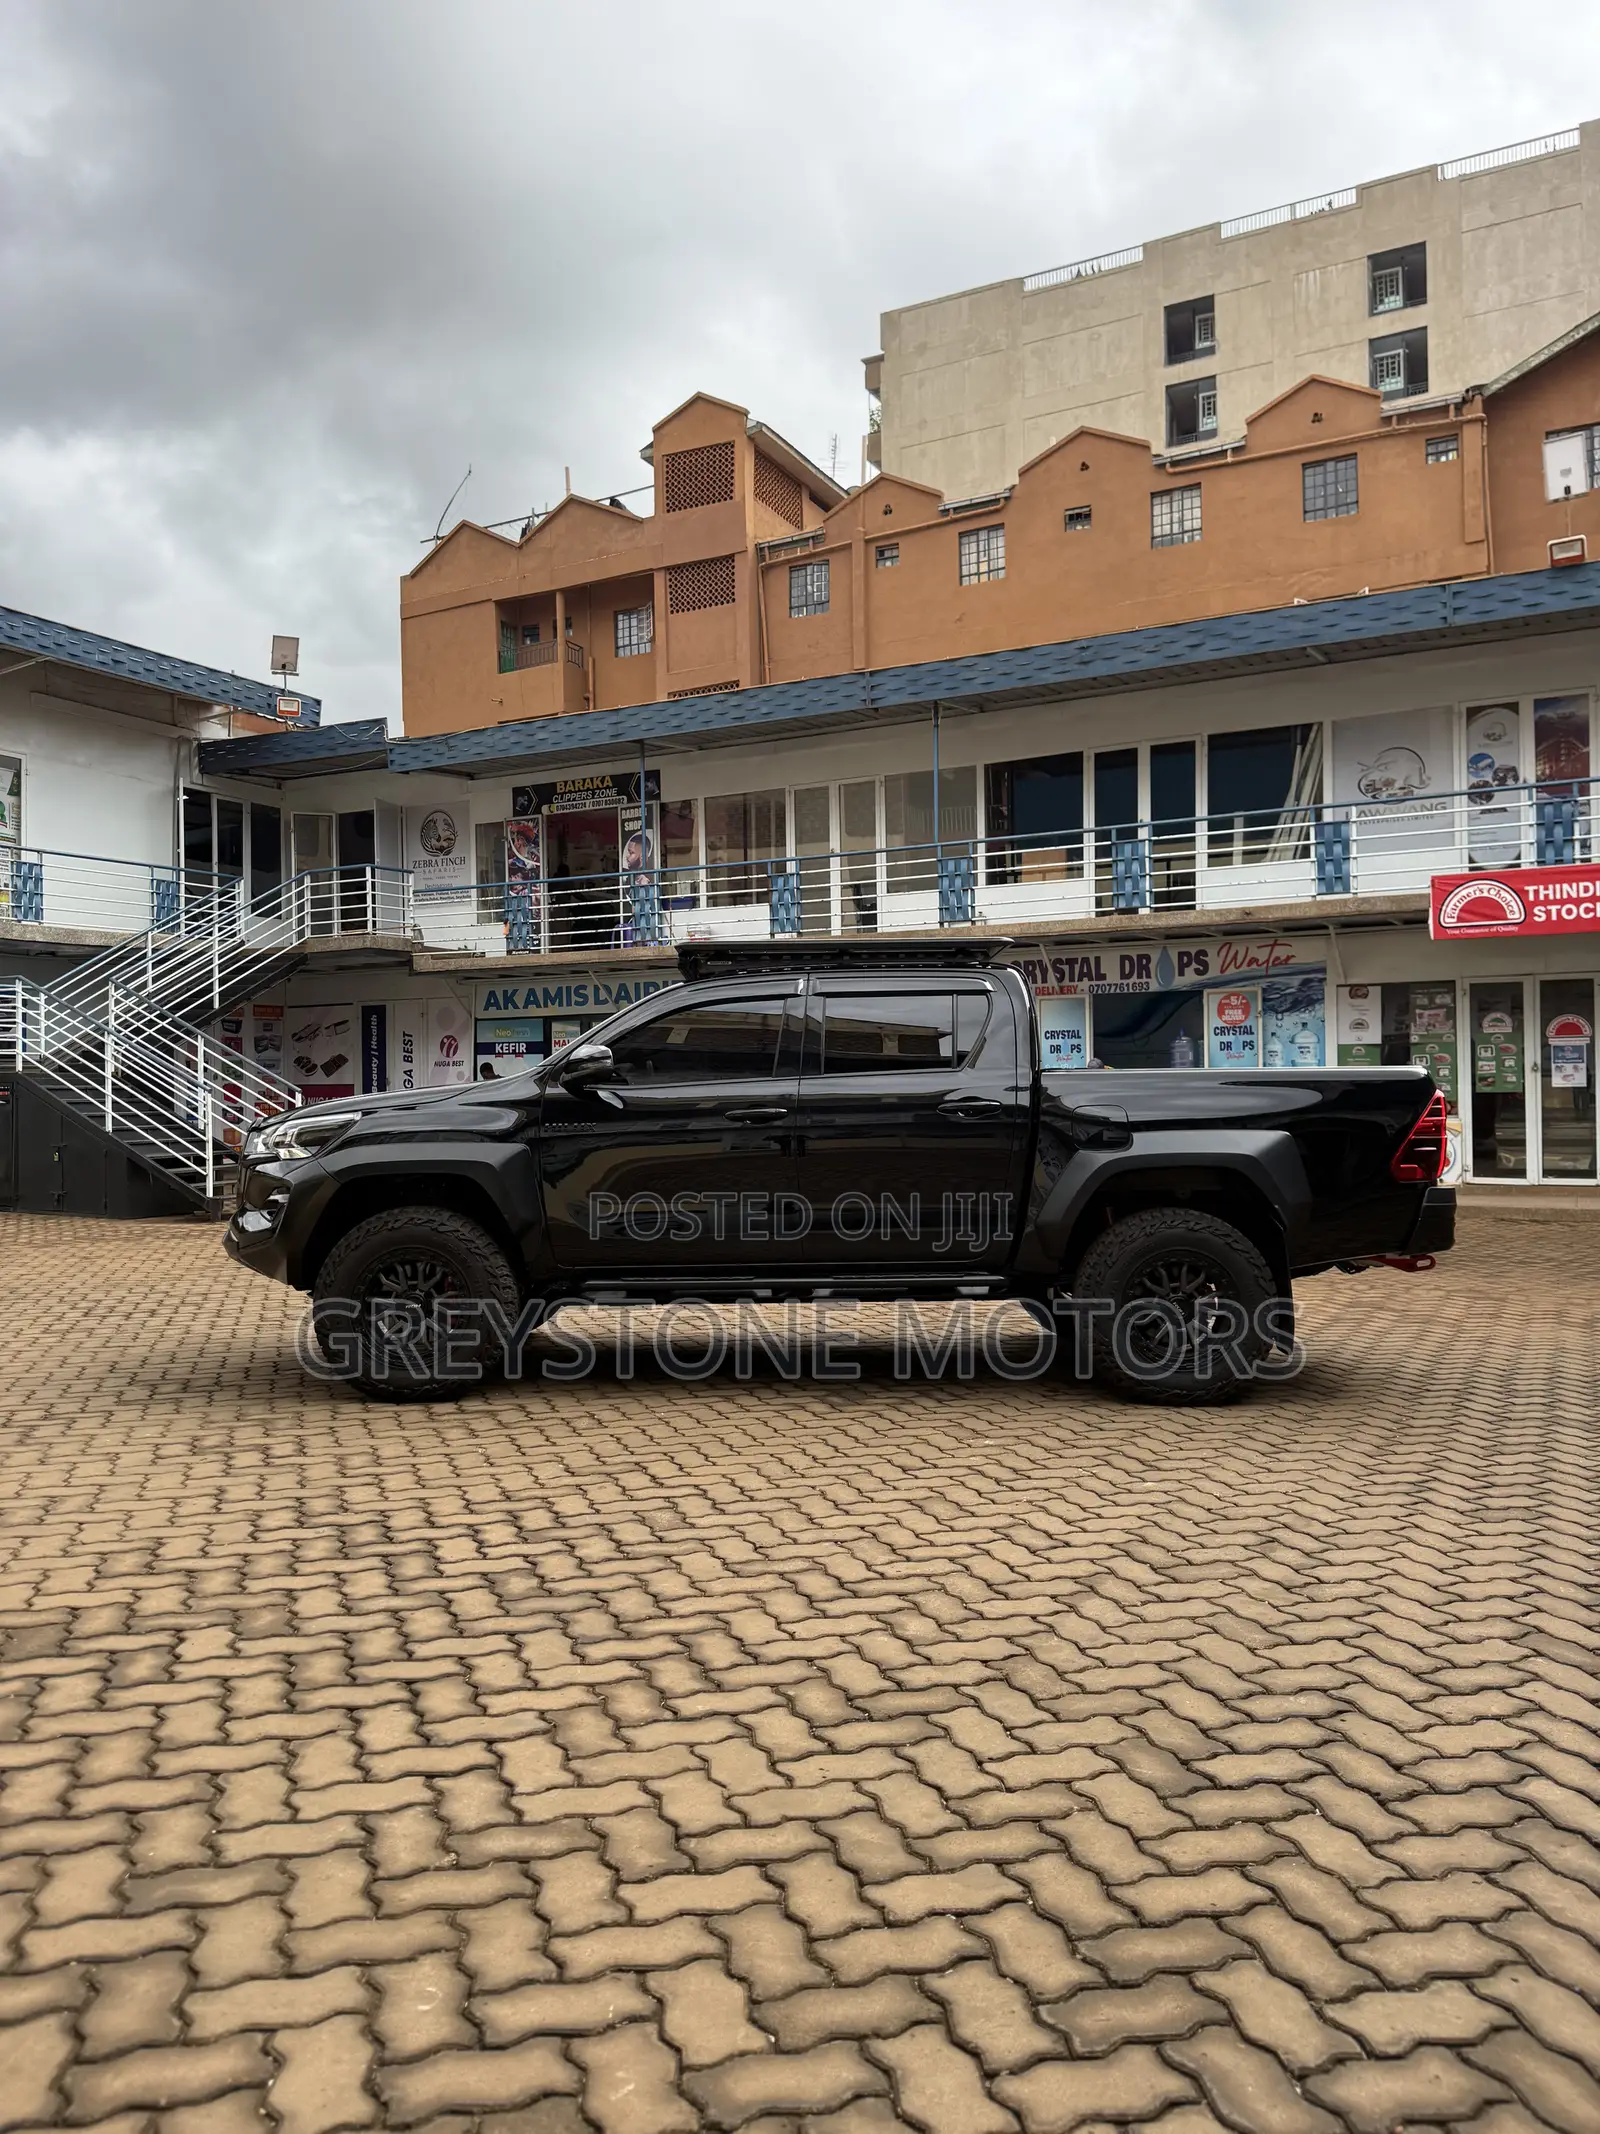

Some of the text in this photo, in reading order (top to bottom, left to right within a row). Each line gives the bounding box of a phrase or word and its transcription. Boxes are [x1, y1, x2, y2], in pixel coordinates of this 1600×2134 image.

[556, 775, 613, 793] BARAKA
[552, 787, 618, 804] CLIPPERS ZONE
[624, 820, 642, 831] SHOP
[413, 856, 466, 869] ZEBRA FINCH
[422, 867, 456, 875] SAFARIS
[1524, 880, 1600, 902] THINDI
[1446, 886, 1517, 920] Farmer's Choice
[1498, 924, 1519, 933] Quality
[1217, 938, 1297, 979] Water
[1088, 981, 1151, 995] 0707761693
[482, 983, 590, 1012] AKAMIS
[1224, 1008, 1243, 1016] FREE
[370, 1014, 378, 1049] Health
[1044, 1029, 1082, 1041] CRYSTAL
[1213, 1024, 1255, 1037] CRYSTAL
[402, 1031, 414, 1064] BEST
[495, 1042, 527, 1054] KEFIR
[370, 1057, 379, 1094] Beauty
